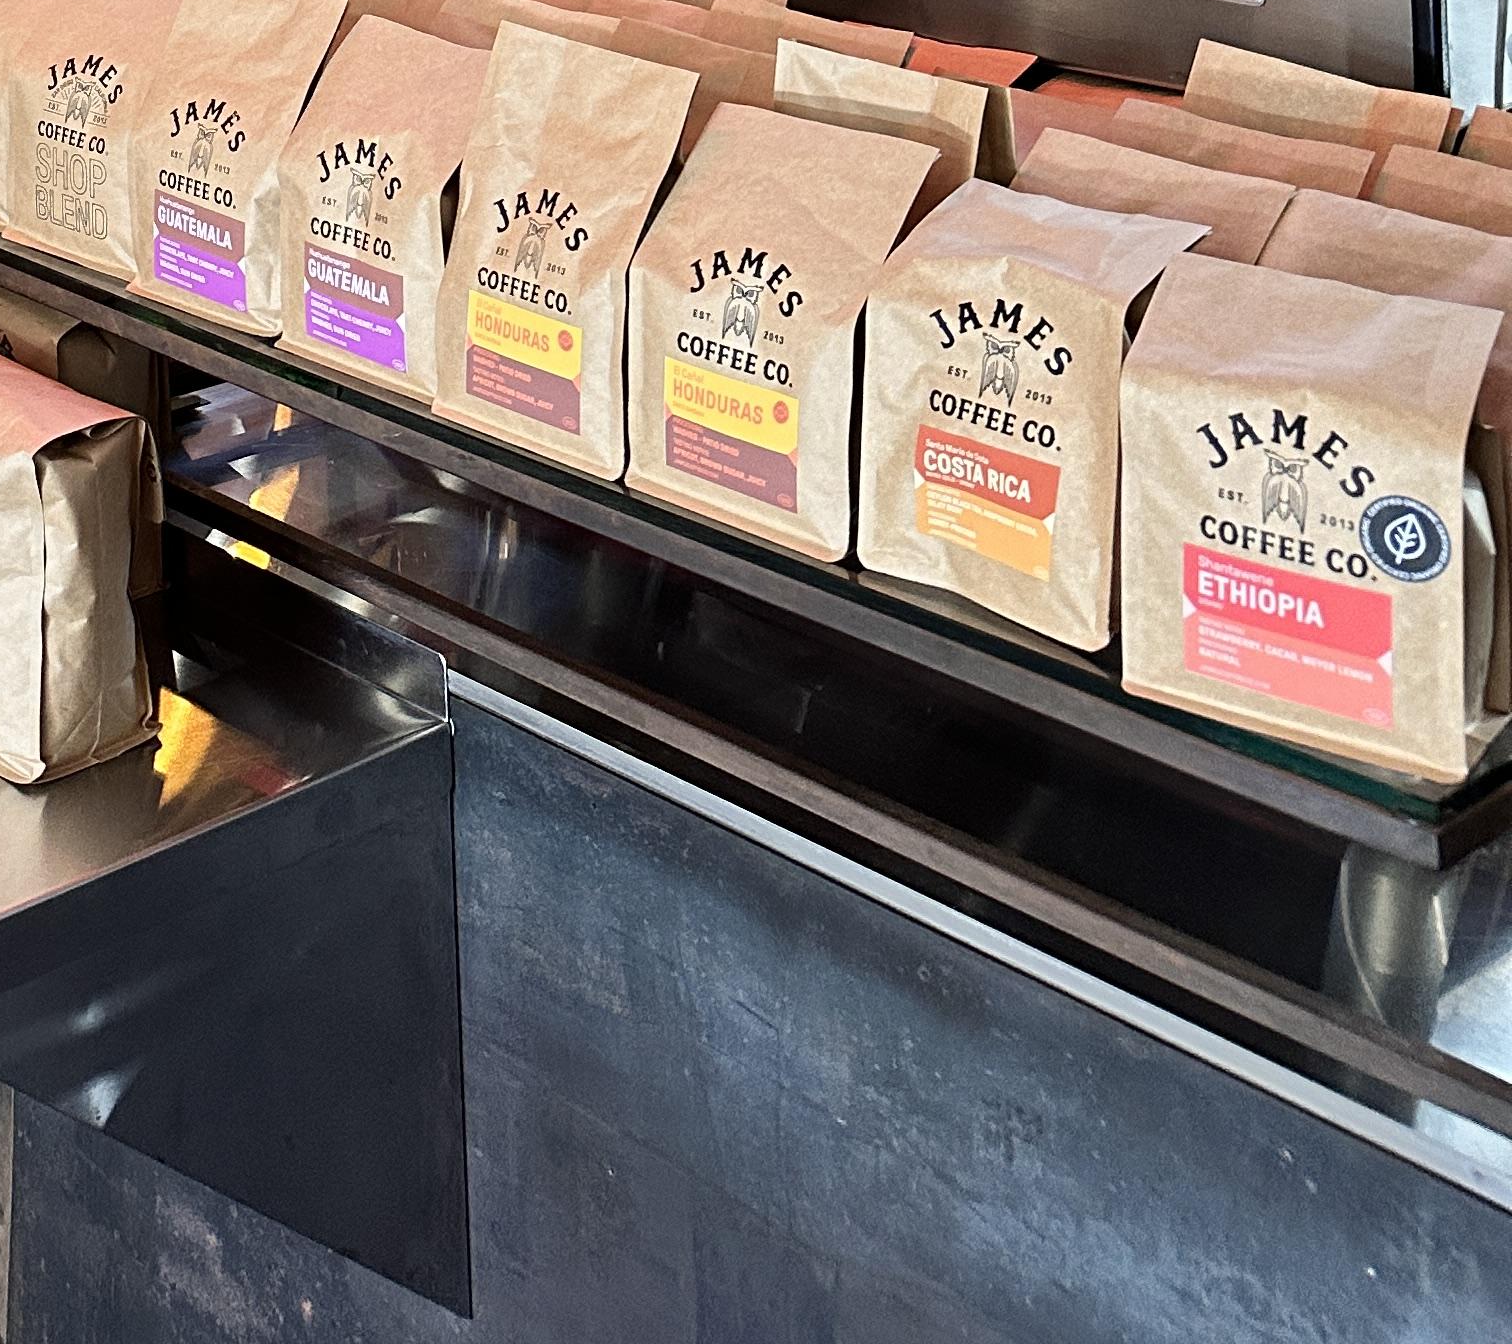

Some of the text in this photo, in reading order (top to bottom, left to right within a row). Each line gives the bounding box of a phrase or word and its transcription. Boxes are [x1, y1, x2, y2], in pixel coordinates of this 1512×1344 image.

[47, 54, 123, 104] JAMES
[37, 120, 109, 156] COFFEE CO.
[168, 98, 247, 153] JAMES
[35, 143, 107, 199] SHOP
[158, 169, 237, 210] COFFEE CO.
[316, 138, 402, 201] JAMES
[36, 185, 108, 240] BLEND
[157, 205, 233, 251] GUATEMALA
[309, 216, 396, 262] COFFEE CO.
[493, 188, 589, 253] JAMES
[307, 258, 390, 306] GUATEMALA
[477, 266, 573, 315] COFFEE CO.
[689, 246, 804, 319] JAMES
[475, 310, 550, 353] HONDURAS
[763, 330, 785, 345] 2013
[928, 298, 1074, 377] JAMES
[676, 330, 794, 389] COFFEE CO.
[673, 379, 764, 425] HONDURAS
[929, 388, 1062, 452] COFFEE CO.
[1025, 389, 1053, 406] 2013
[923, 449, 1031, 504] COSTA RICA
[1196, 408, 1377, 499] JAMES
[1199, 513, 1316, 568] COFFEE
[1325, 547, 1378, 582] CO.
[1319, 512, 1355, 532] 2013
[1198, 569, 1325, 629] ETHIOPIA
